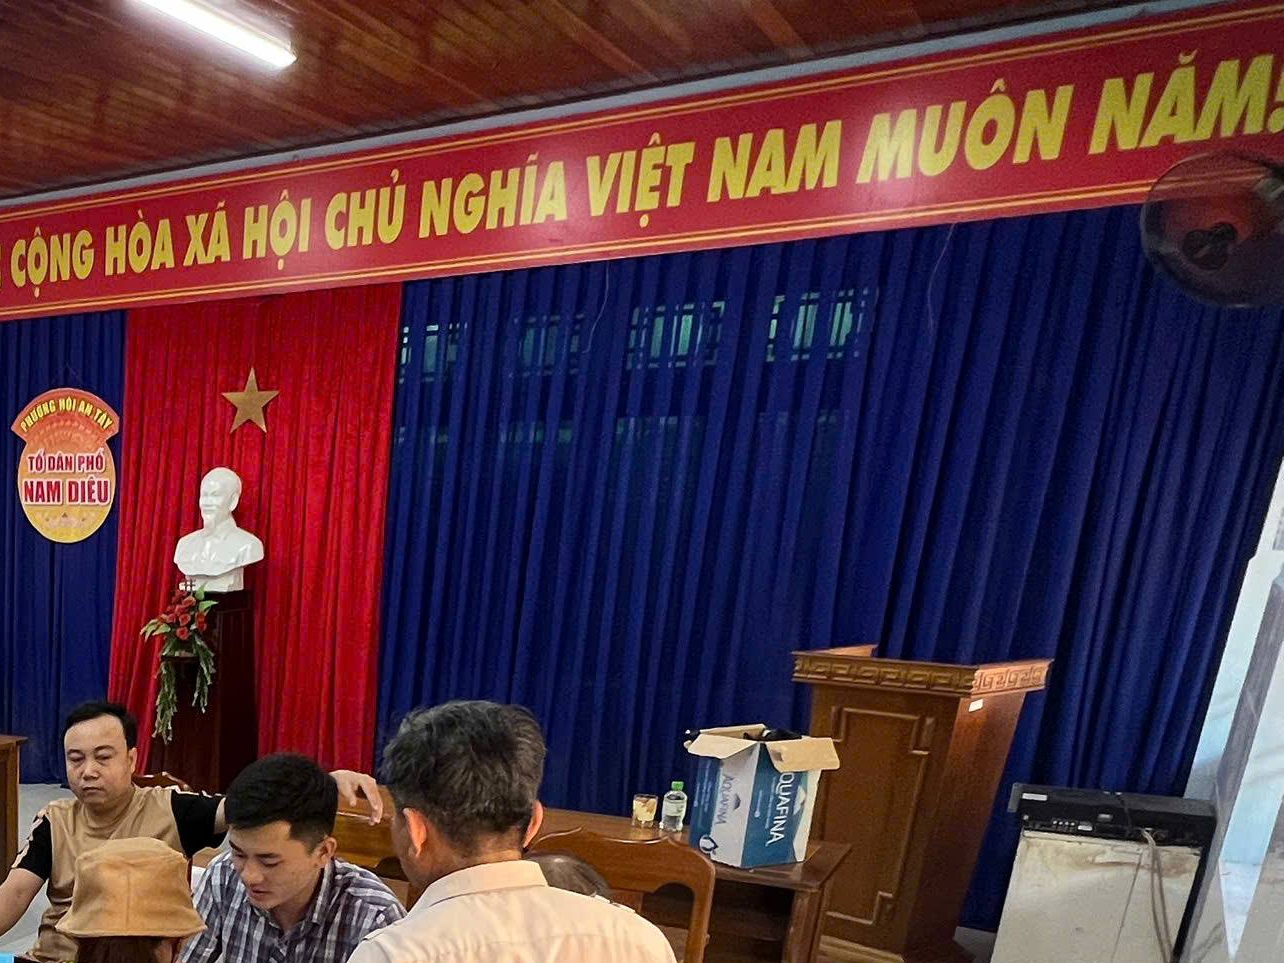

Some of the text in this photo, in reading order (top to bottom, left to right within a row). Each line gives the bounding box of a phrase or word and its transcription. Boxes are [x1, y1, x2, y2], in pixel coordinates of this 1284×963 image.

[10, 227, 95, 298] CỘNG
[105, 208, 175, 276] HÒA
[183, 199, 231, 266] XÃ
[242, 189, 312, 271] HỘI
[324, 169, 406, 250] CHỦ
[418, 150, 568, 239] NGHĨA
[586, 132, 696, 228] VIỆT
[707, 119, 842, 202] NAM
[856, 78, 1074, 184] MUÔN
[78, 400, 94, 417] AN
[47, 451, 74, 472] DÂN
[23, 479, 62, 504] NAM
[714, 773, 734, 826] AQUAFINA
[766, 771, 795, 847] QUAFINA
